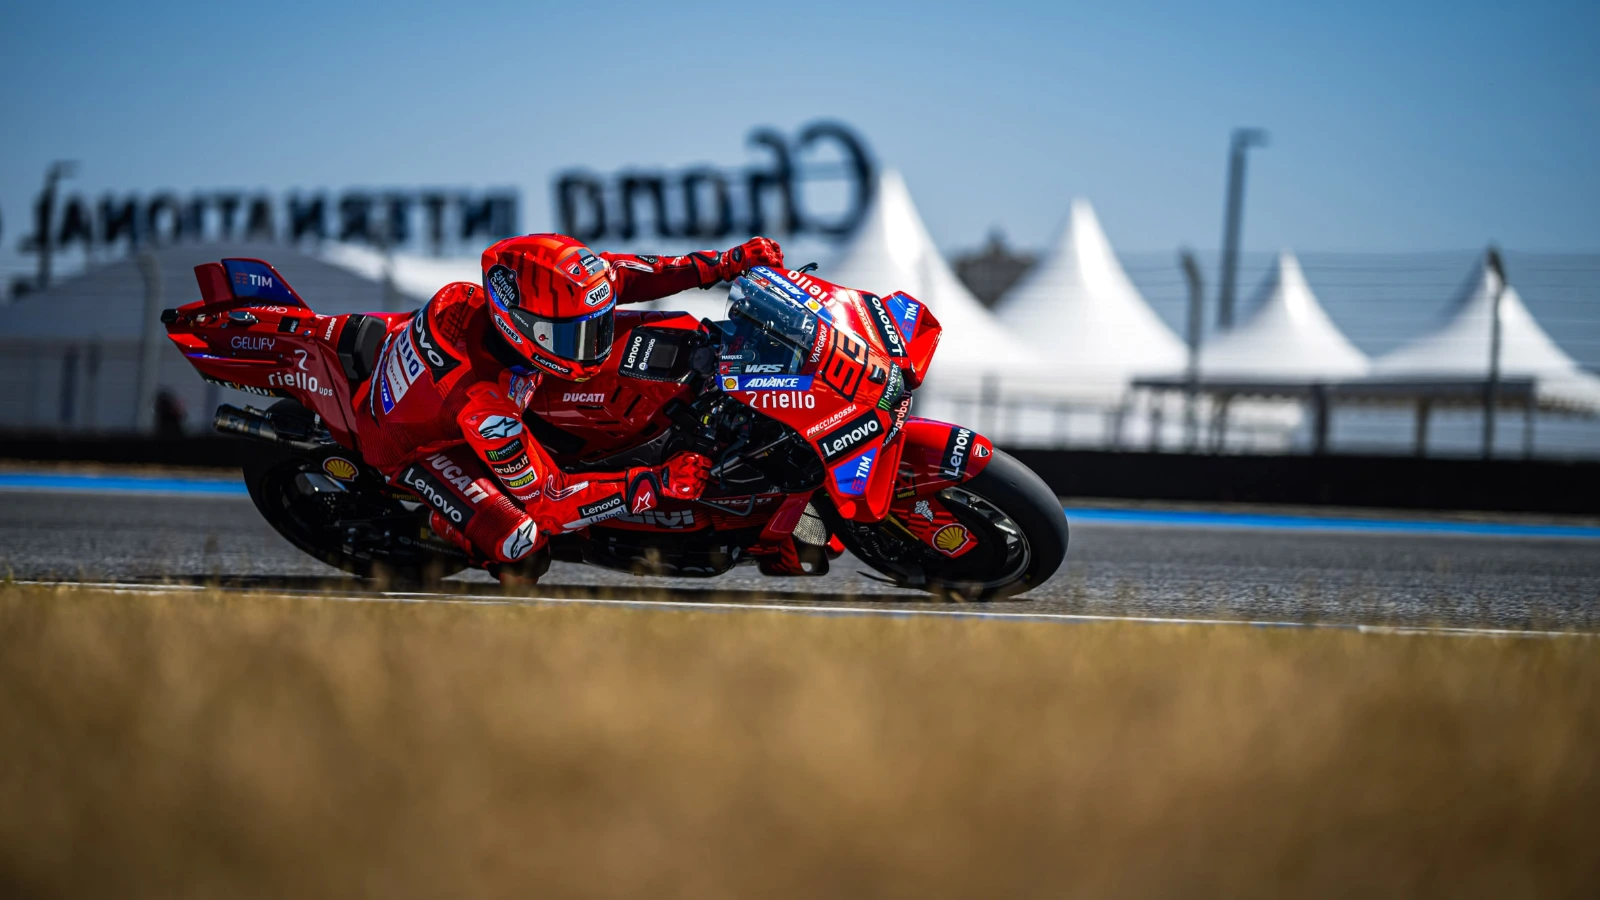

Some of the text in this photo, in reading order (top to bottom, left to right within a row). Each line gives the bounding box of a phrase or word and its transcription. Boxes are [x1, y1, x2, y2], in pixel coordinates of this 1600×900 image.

[249, 274, 273, 288] TIM
[490, 276, 510, 306] Galicia
[494, 269, 516, 301] Estrella
[589, 283, 609, 304] SHOEI
[904, 302, 919, 321] TIM
[324, 317, 337, 341] DUCATI
[496, 316, 519, 343] SHOEI
[871, 297, 903, 357] Lenovo
[231, 336, 276, 350] GELLIFY
[624, 336, 643, 369] Lenovo
[643, 338, 656, 362] motorola
[809, 323, 828, 363] VARGROUP
[534, 354, 569, 374] Lenovo
[744, 364, 784, 373] WRS
[819, 328, 871, 404] 93
[268, 371, 333, 397] riello ups
[744, 377, 800, 388] ADVANCE
[562, 392, 605, 403] DUCATI
[762, 390, 816, 409] riello
[806, 403, 858, 437] FRECCIAROSSA
[822, 419, 879, 457] Lenovo
[856, 455, 872, 479] TIM
[404, 467, 463, 523] Lenovo
[581, 497, 621, 517] Lenovo
